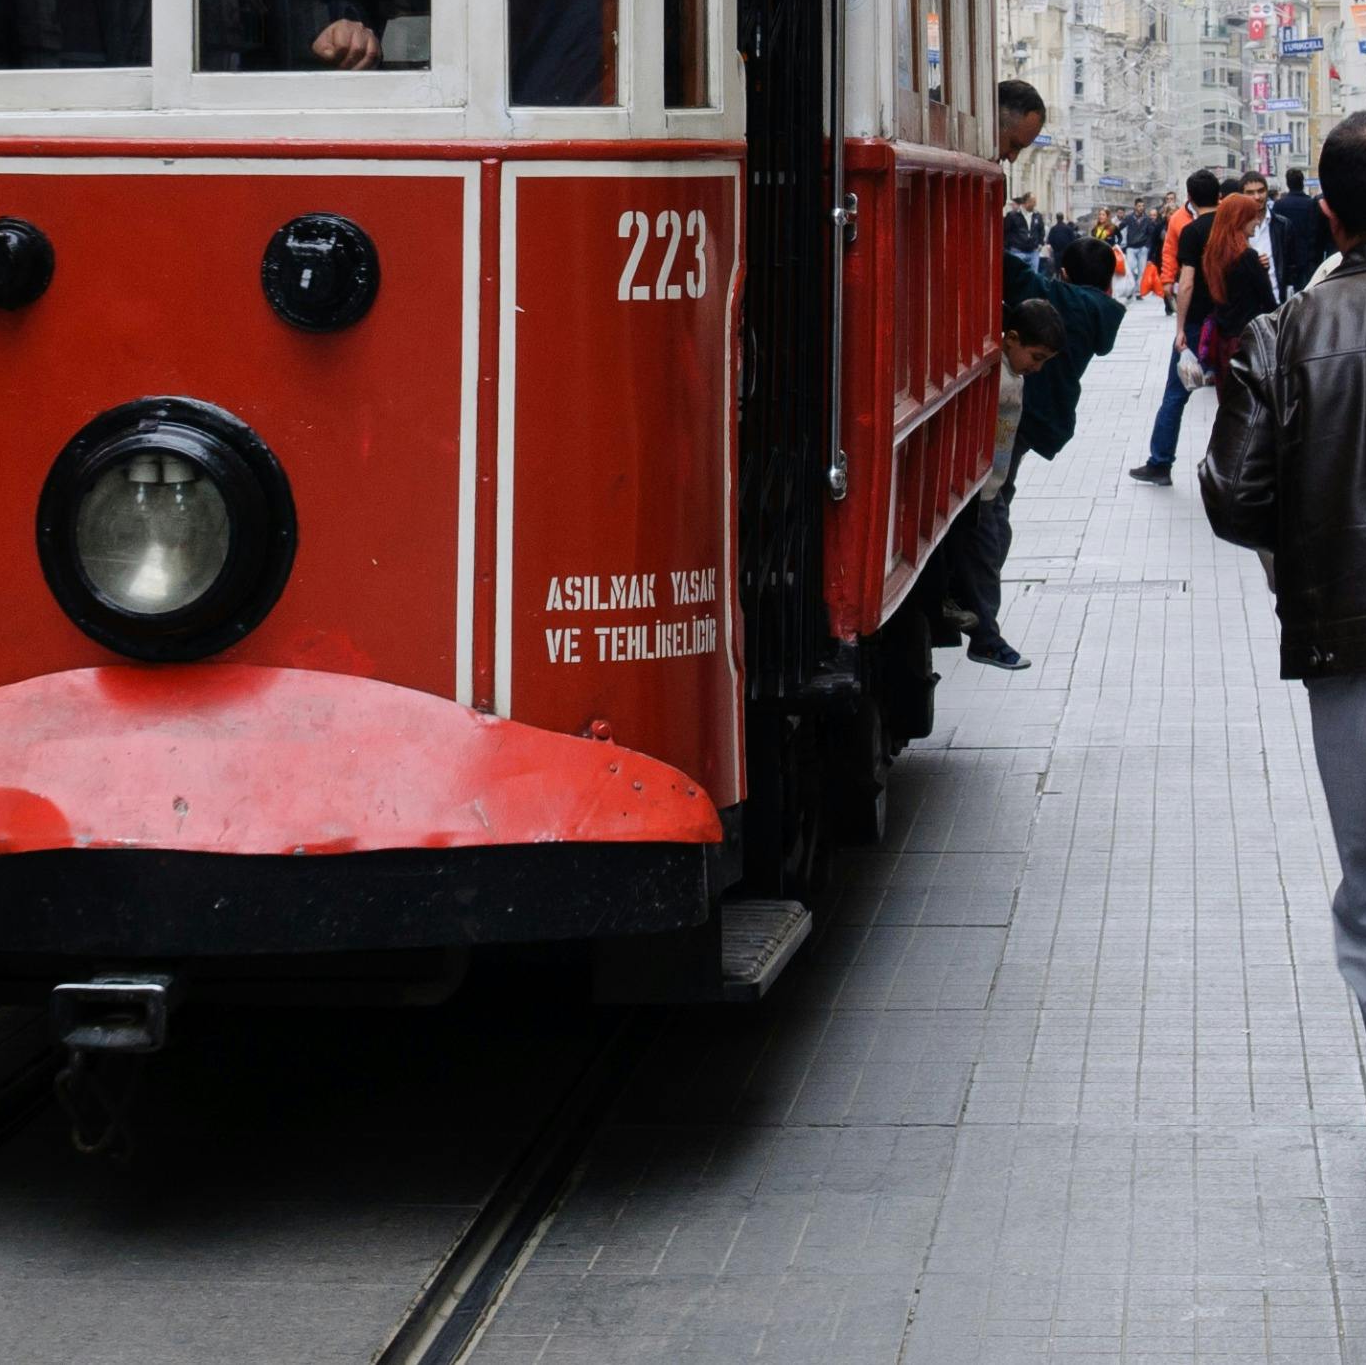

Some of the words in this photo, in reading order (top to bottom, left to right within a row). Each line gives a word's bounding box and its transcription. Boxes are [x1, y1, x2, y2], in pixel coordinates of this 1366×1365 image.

[1284, 40, 1323, 52] TURKCELL
[618, 209, 706, 301] 223
[545, 573, 656, 611] ASILMAK
[670, 567, 716, 605] YASAK
[545, 627, 581, 664] VE
[594, 613, 716, 662] TEHLİKELİDİR
